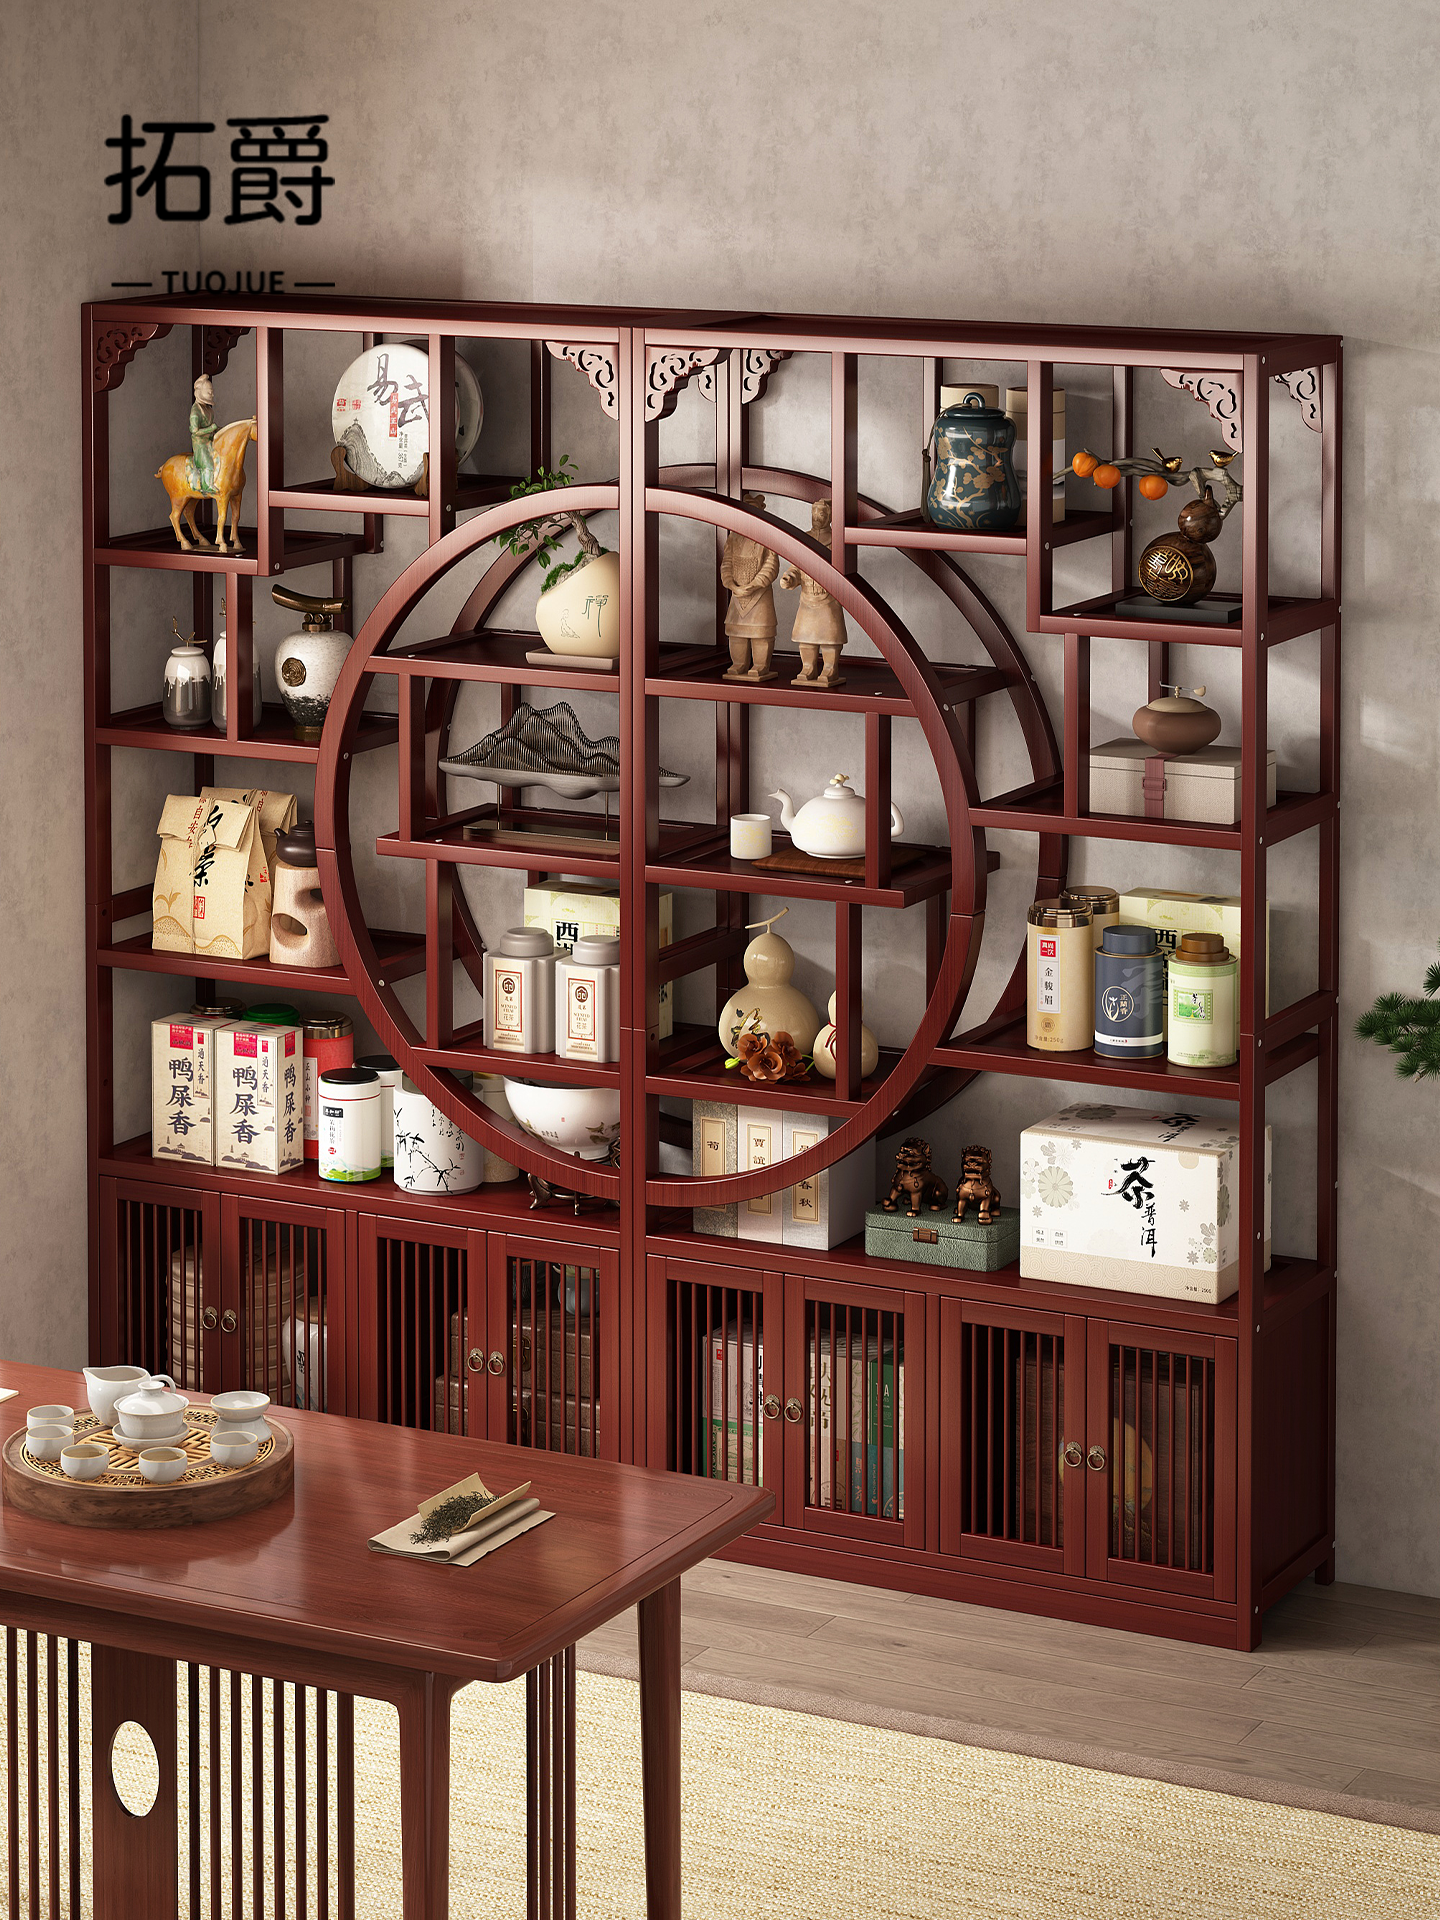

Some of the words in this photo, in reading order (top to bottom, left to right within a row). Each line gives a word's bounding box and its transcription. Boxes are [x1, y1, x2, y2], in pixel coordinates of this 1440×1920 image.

[1044, 967, 1053, 1005] 金骏眉
[166, 1057, 196, 1136] 鸭屎香
[229, 1065, 261, 1145] 鸭屎香
[283, 1063, 297, 1144] 鸭屎香
